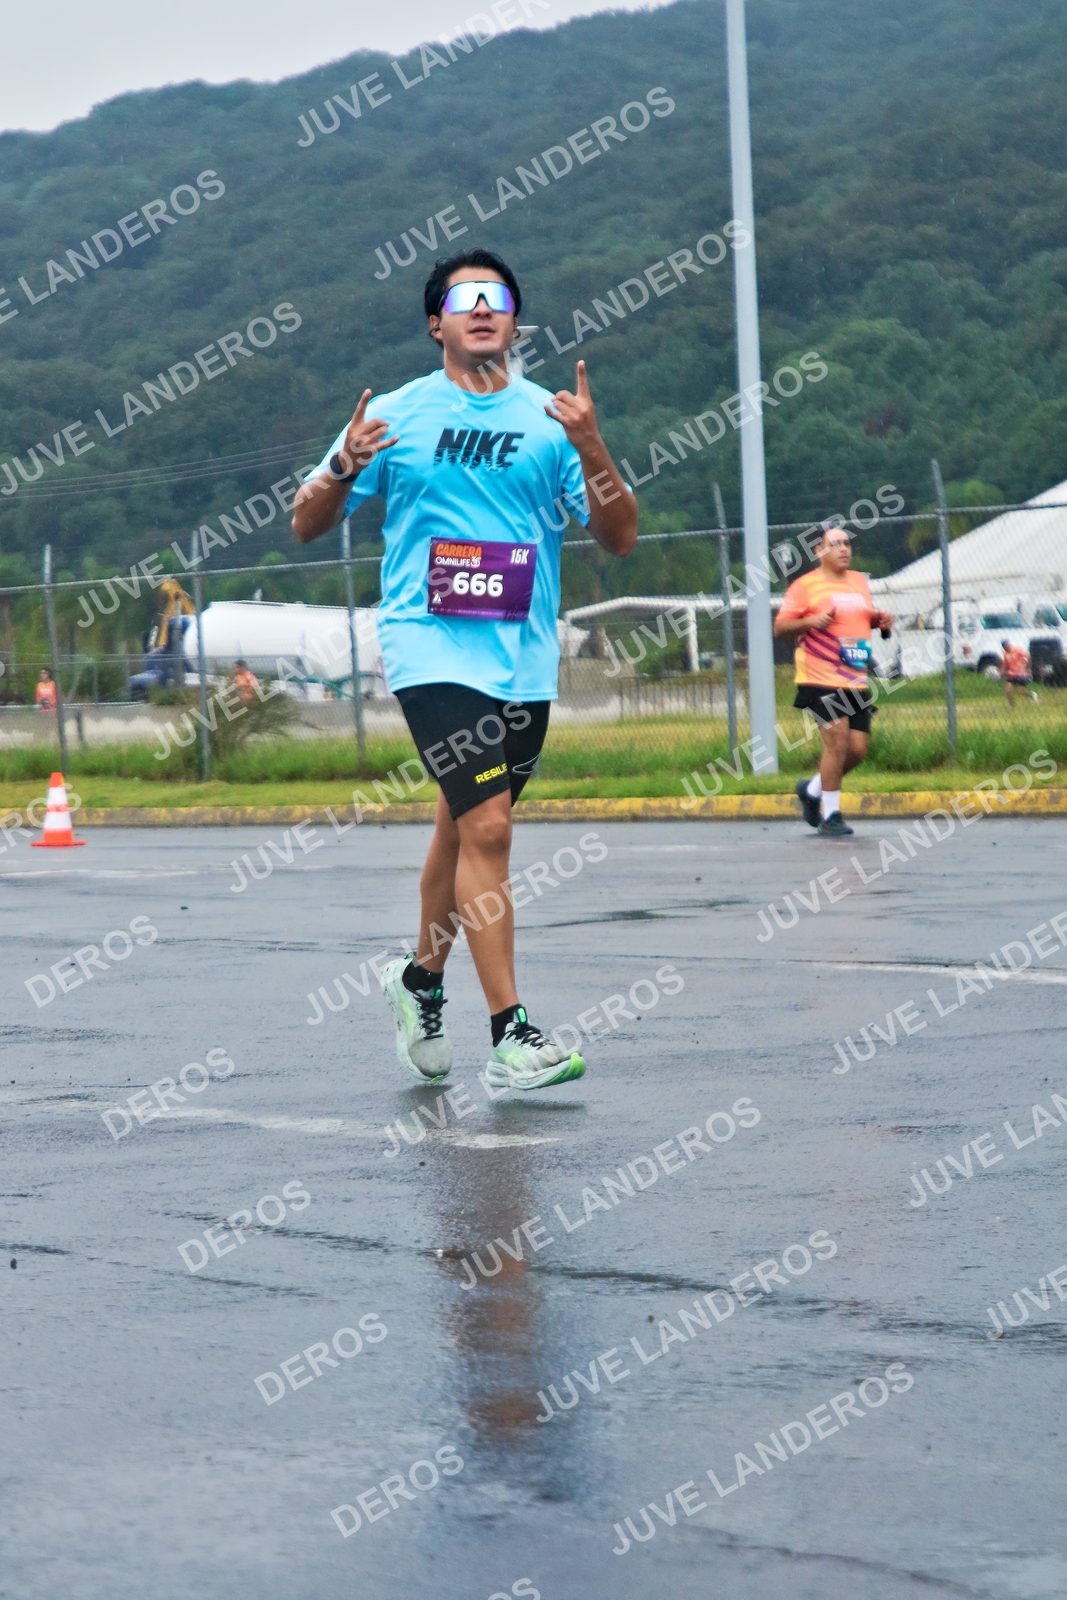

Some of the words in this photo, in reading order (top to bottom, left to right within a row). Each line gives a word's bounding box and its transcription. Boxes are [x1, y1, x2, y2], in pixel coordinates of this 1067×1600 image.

[433, 427, 525, 472] NIKE
[435, 543, 482, 557] CARRERA
[453, 572, 504, 597] 666
